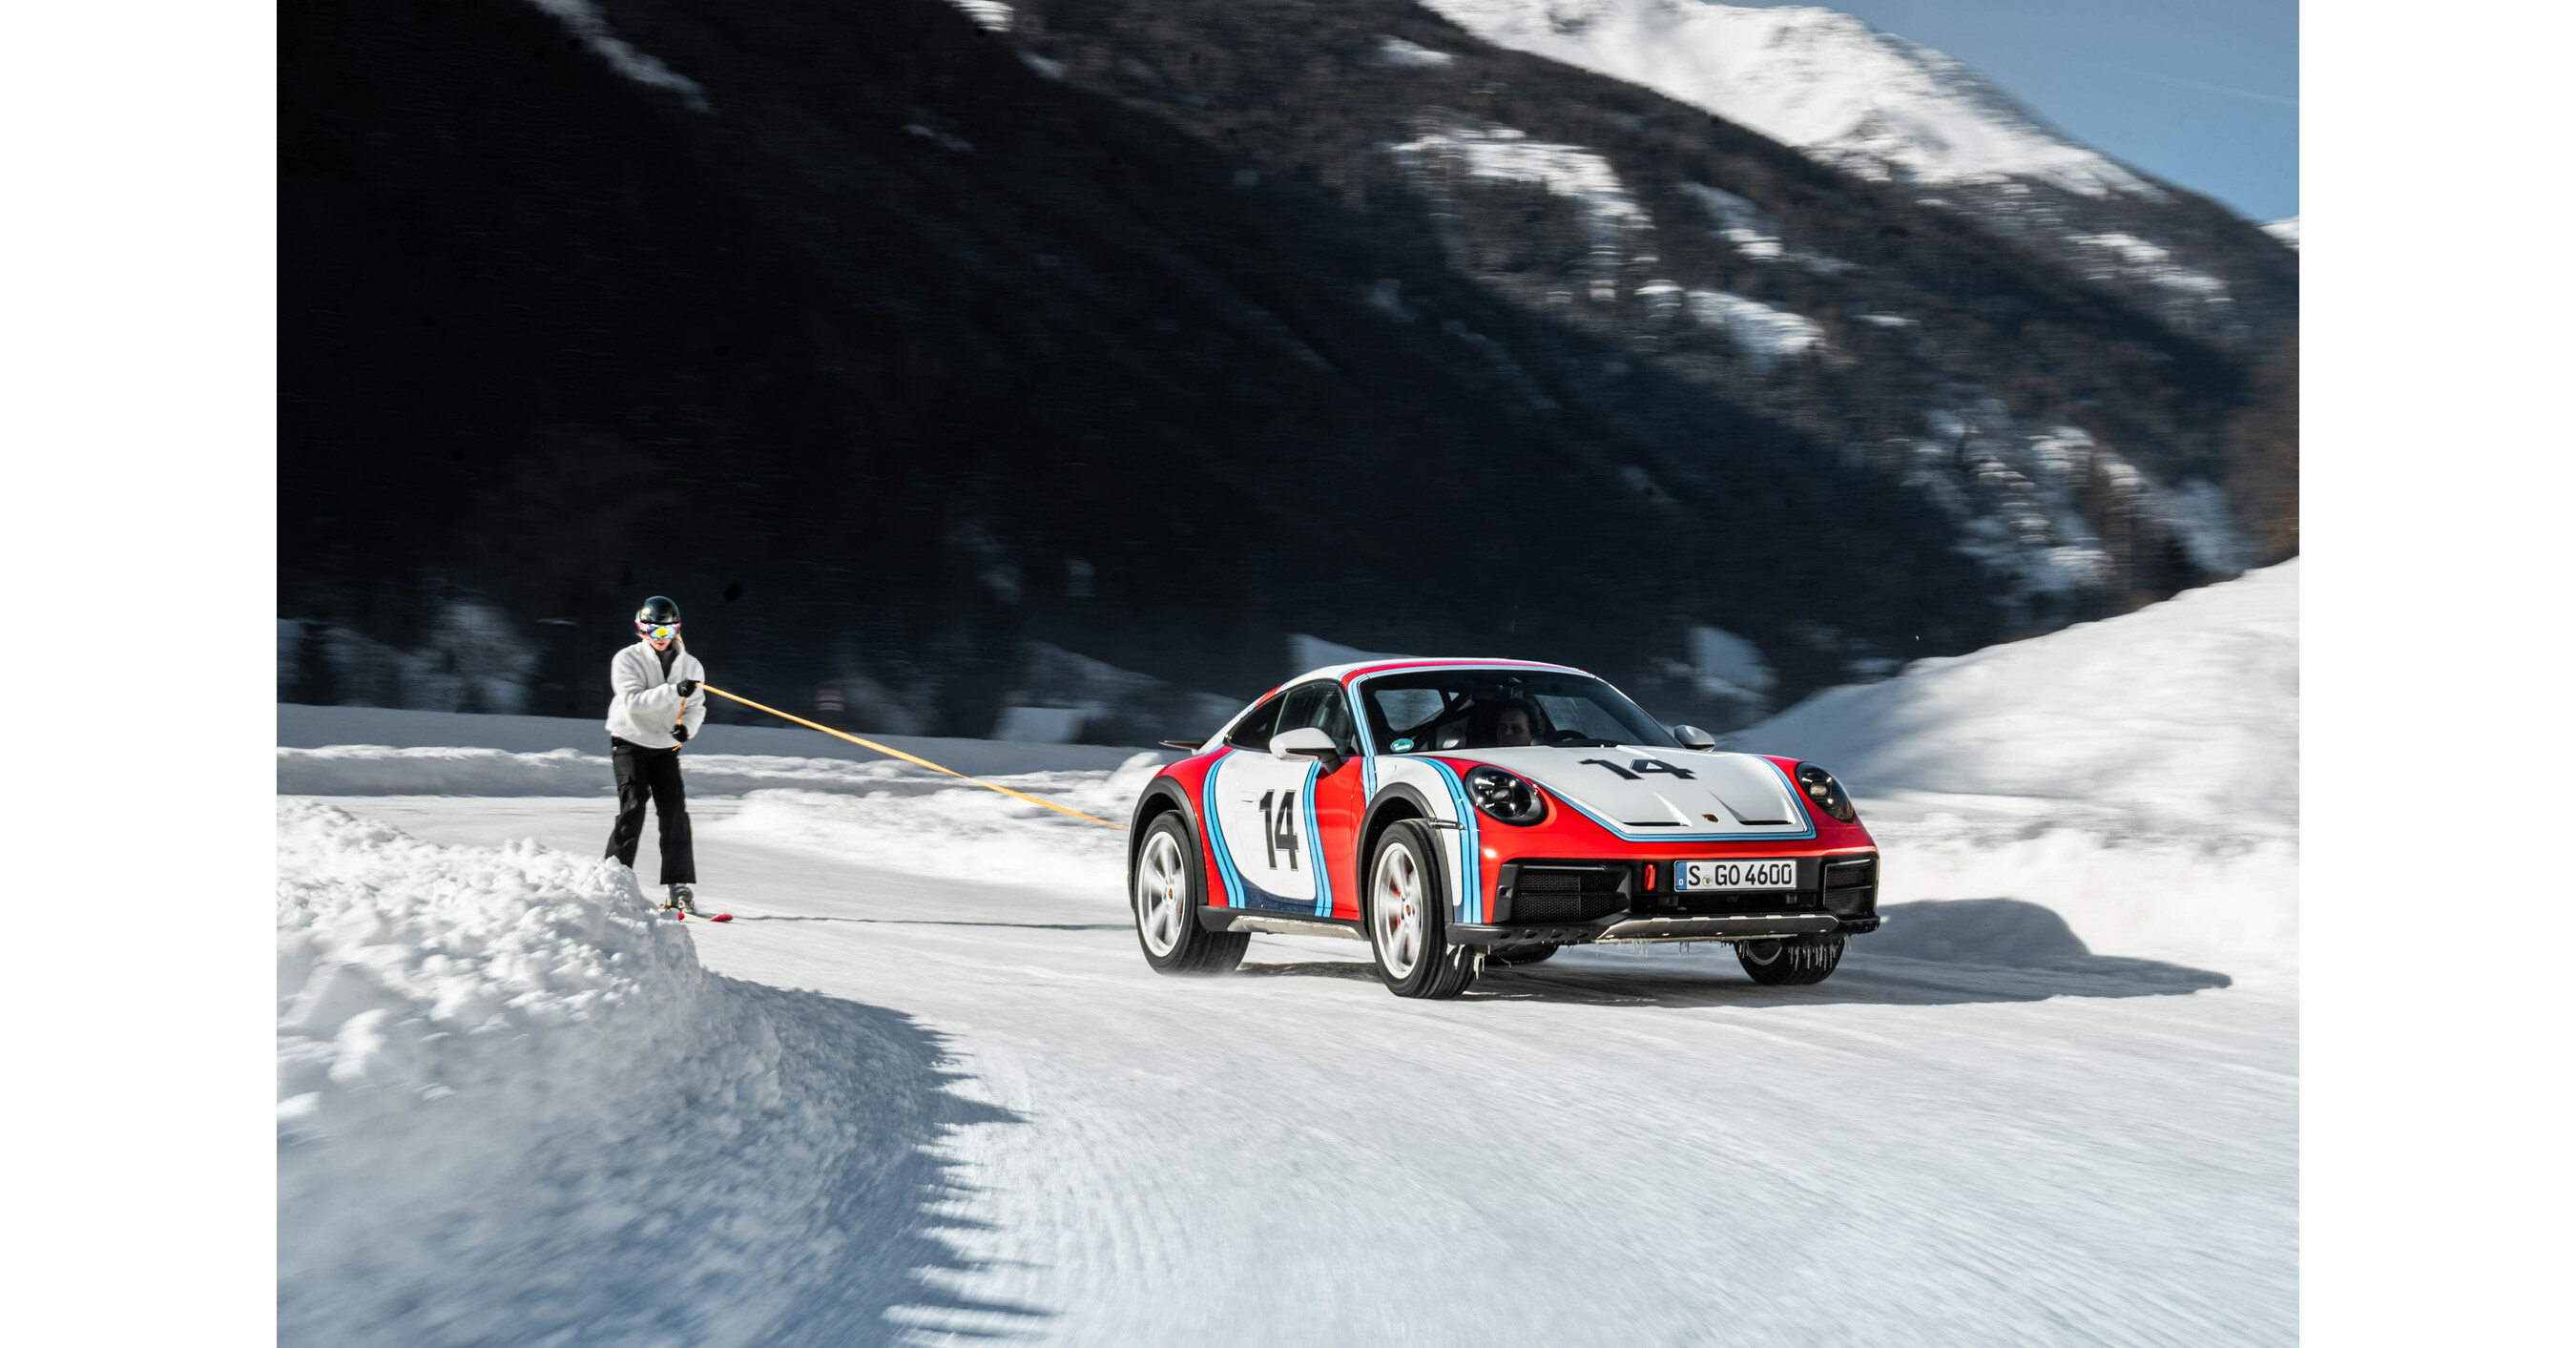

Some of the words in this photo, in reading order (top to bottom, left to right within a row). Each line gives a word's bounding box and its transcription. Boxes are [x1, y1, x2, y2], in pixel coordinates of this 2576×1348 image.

[1576, 758, 1698, 780] 14
[1258, 789, 1299, 872] 14
[1688, 864, 1701, 886] S
[1714, 864, 1740, 886] GO
[1744, 863, 1793, 885] 4600
